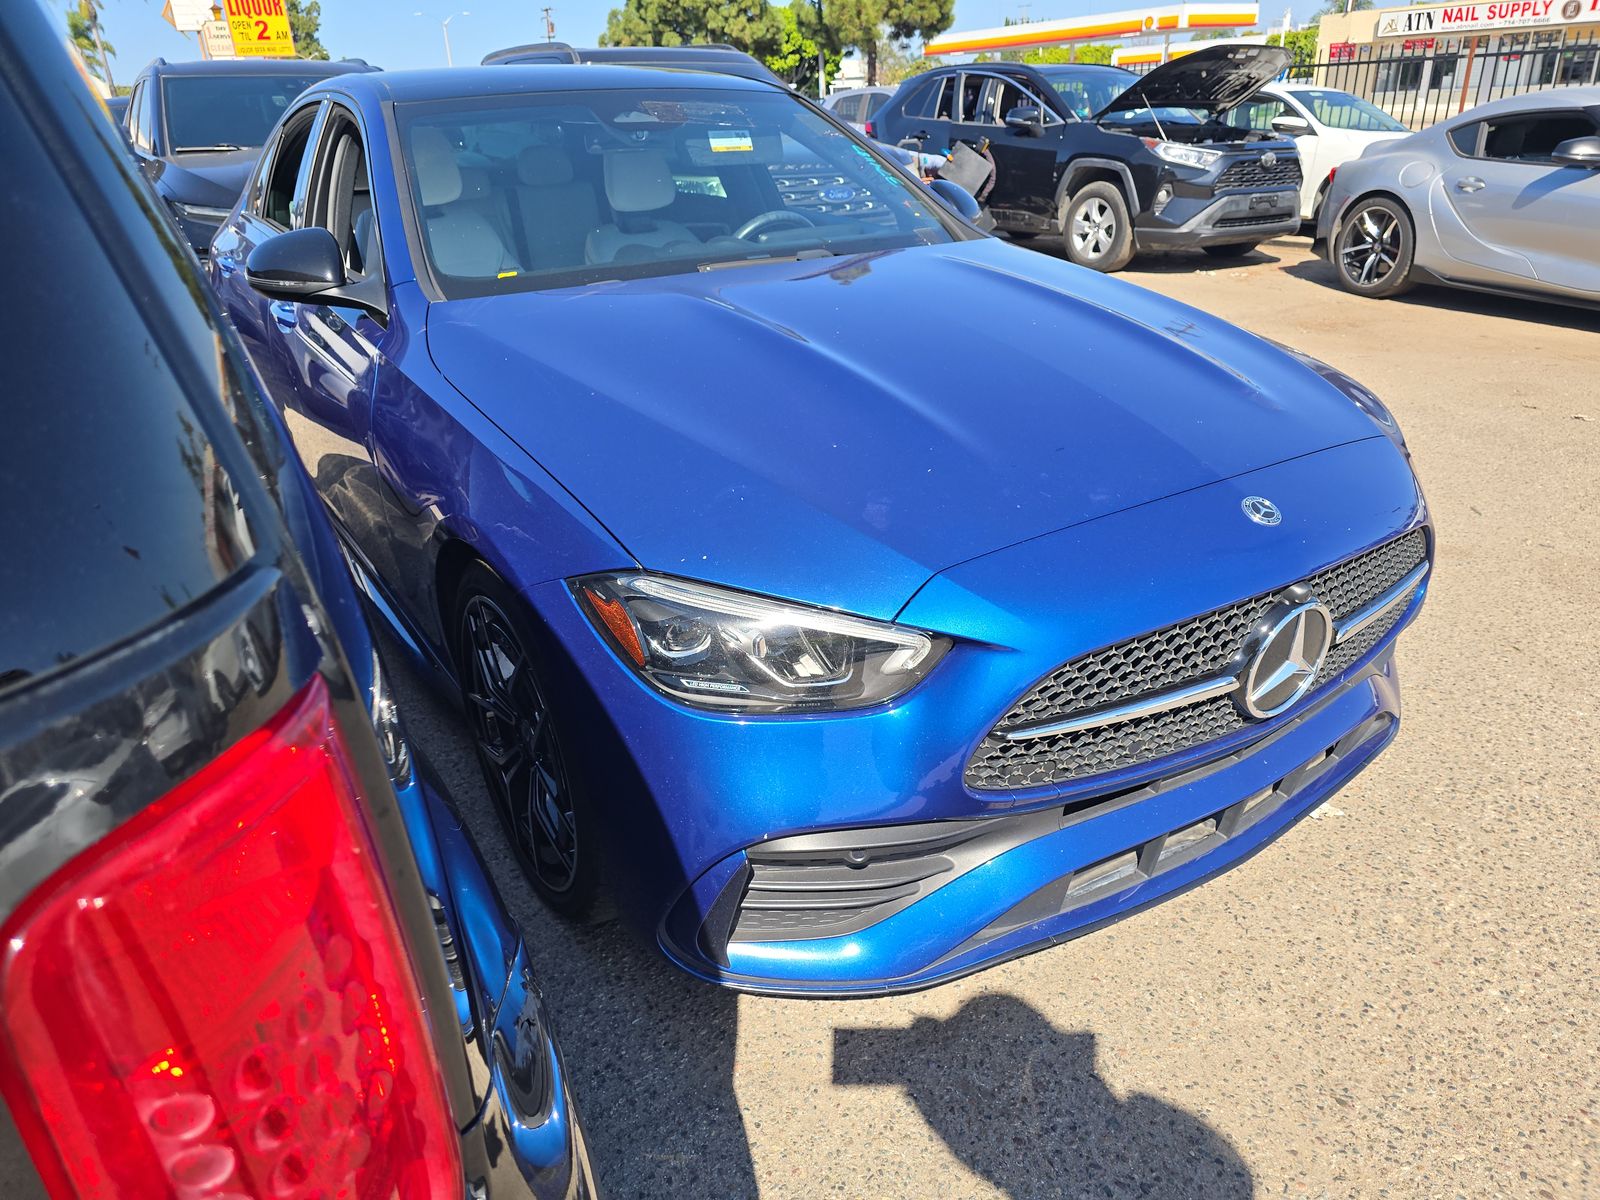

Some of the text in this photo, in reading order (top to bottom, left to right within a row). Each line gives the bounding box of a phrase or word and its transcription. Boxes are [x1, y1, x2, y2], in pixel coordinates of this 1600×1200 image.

[227, 0, 283, 18] LIQUOR
[1442, 6, 1479, 23] NAIL
[1487, 0, 1553, 20] SUPPLY
[232, 21, 252, 30] OPEN
[255, 20, 271, 40] 2
[1402, 11, 1435, 32] ATN
[276, 31, 289, 40] AM
